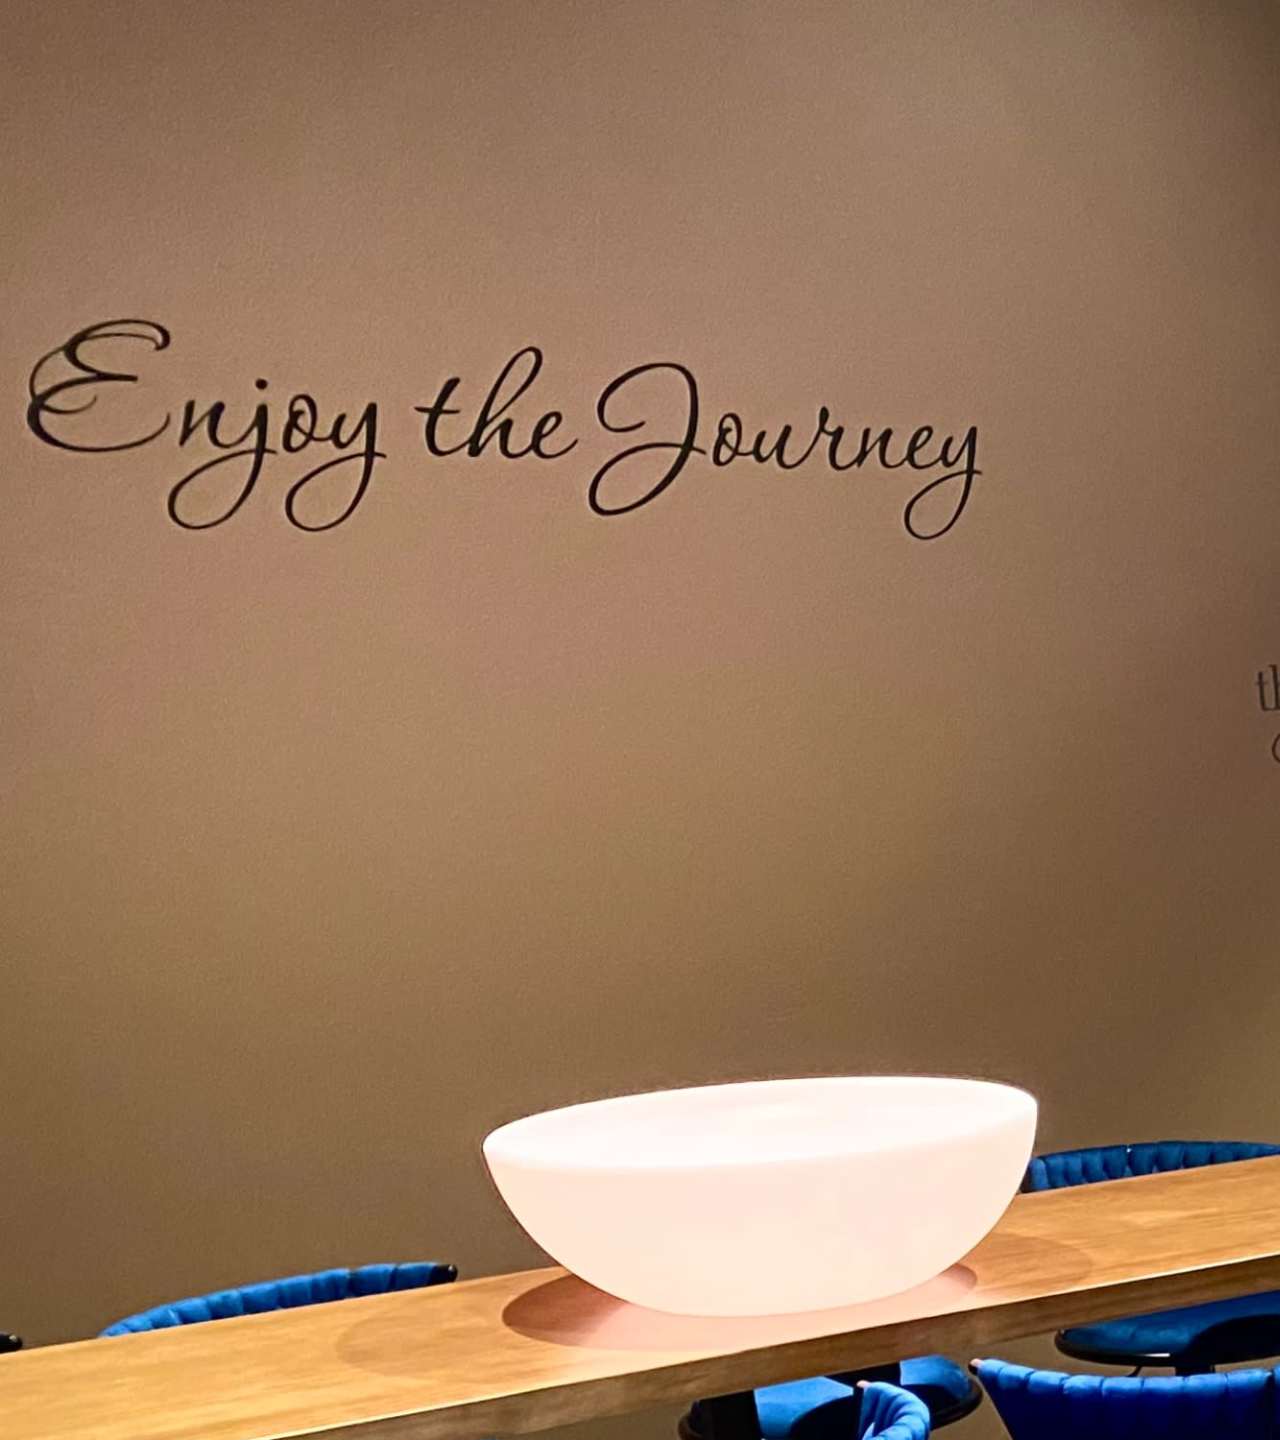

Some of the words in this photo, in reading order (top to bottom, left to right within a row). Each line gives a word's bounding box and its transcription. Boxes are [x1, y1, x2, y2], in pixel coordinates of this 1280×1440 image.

[26, 318, 387, 533] Enjoy
[414, 346, 579, 460] the
[588, 362, 983, 541] Journey
